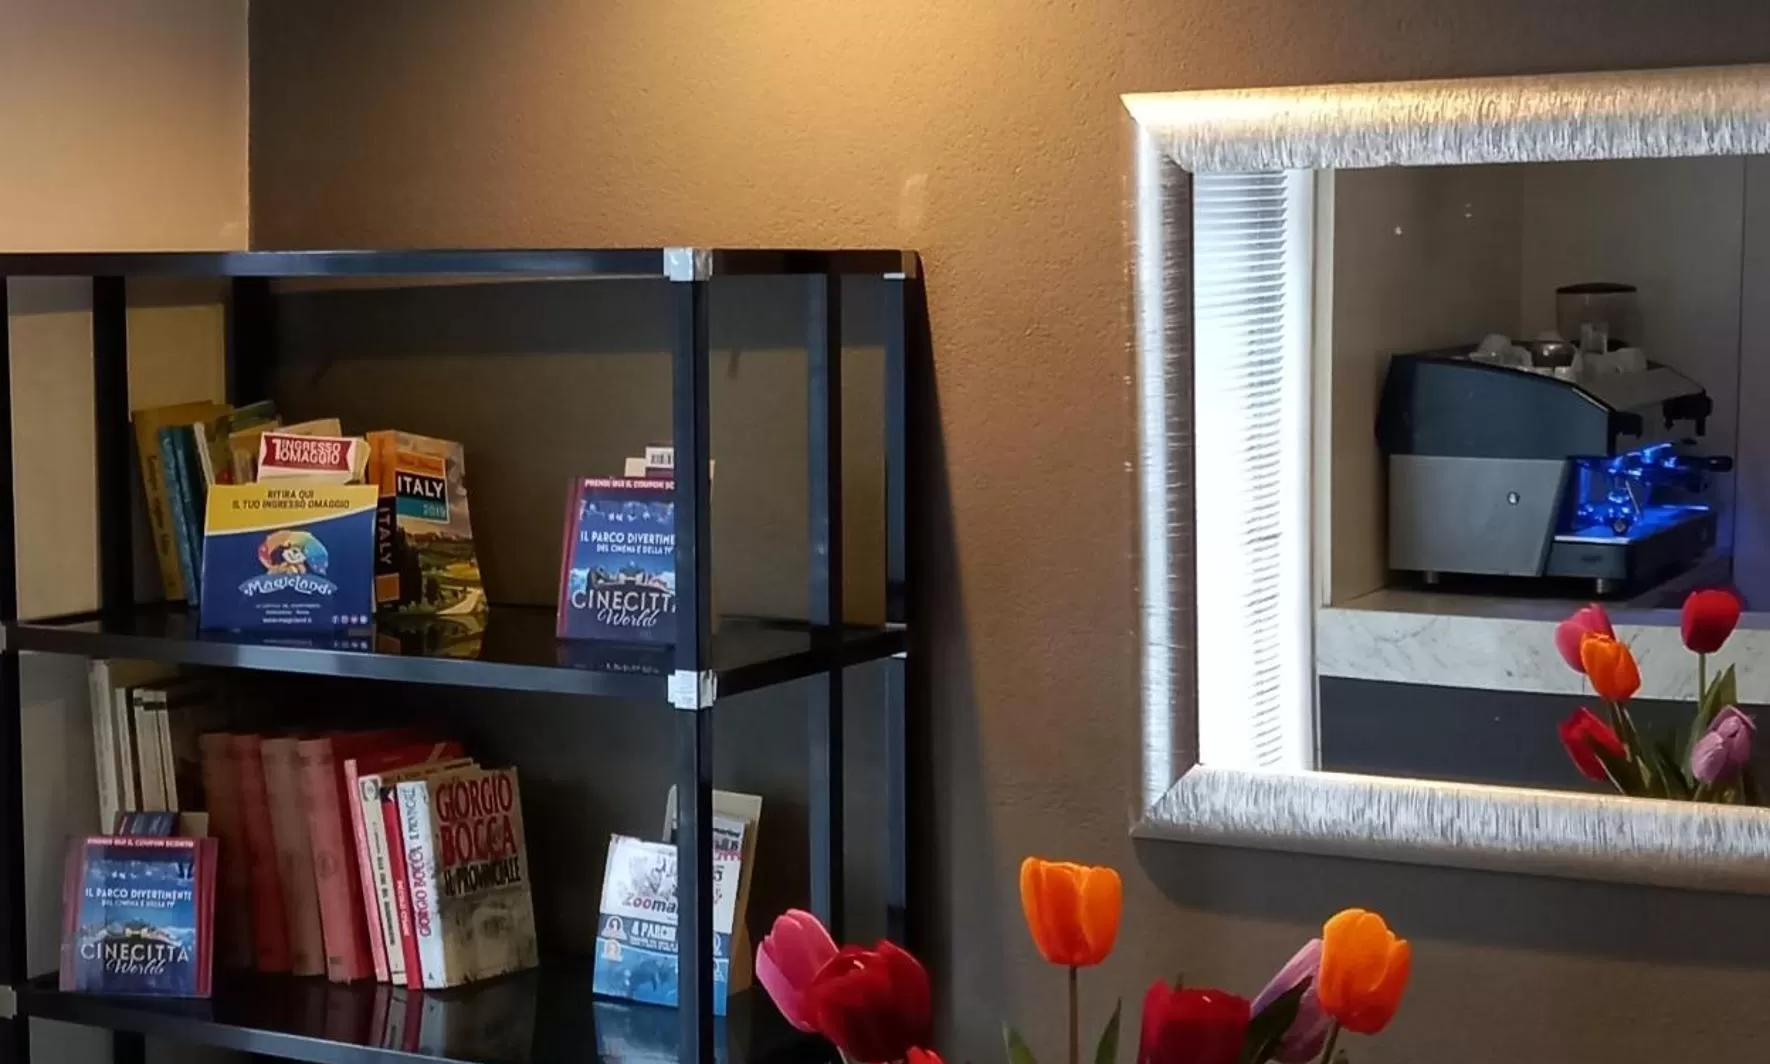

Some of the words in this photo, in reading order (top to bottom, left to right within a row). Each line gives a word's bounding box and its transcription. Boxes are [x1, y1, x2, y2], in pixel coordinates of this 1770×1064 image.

[281, 439, 342, 454] INGRESSO
[281, 449, 341, 465] OMAGGIO
[267, 489, 296, 499] RITIRA
[298, 489, 315, 501] QUI
[397, 475, 444, 500] ITALY
[231, 500, 241, 510] IL
[242, 499, 261, 510] TUO
[262, 499, 307, 510] INGRESSO
[308, 500, 351, 510] OMAGGIO
[379, 507, 393, 565] ITALY
[580, 530, 589, 542] IL
[592, 531, 625, 544] PARCO
[627, 533, 676, 546] DIVERTIME
[611, 544, 636, 554] CINEMA
[642, 546, 663, 556] DELLA
[597, 606, 660, 628] World
[436, 772, 514, 823] GIORGIO
[440, 814, 517, 873] BOCCA
[85, 887, 94, 897] IL
[96, 887, 129, 899] PARCO
[621, 892, 677, 914] Zooma
[414, 890, 432, 938] GIORGIO
